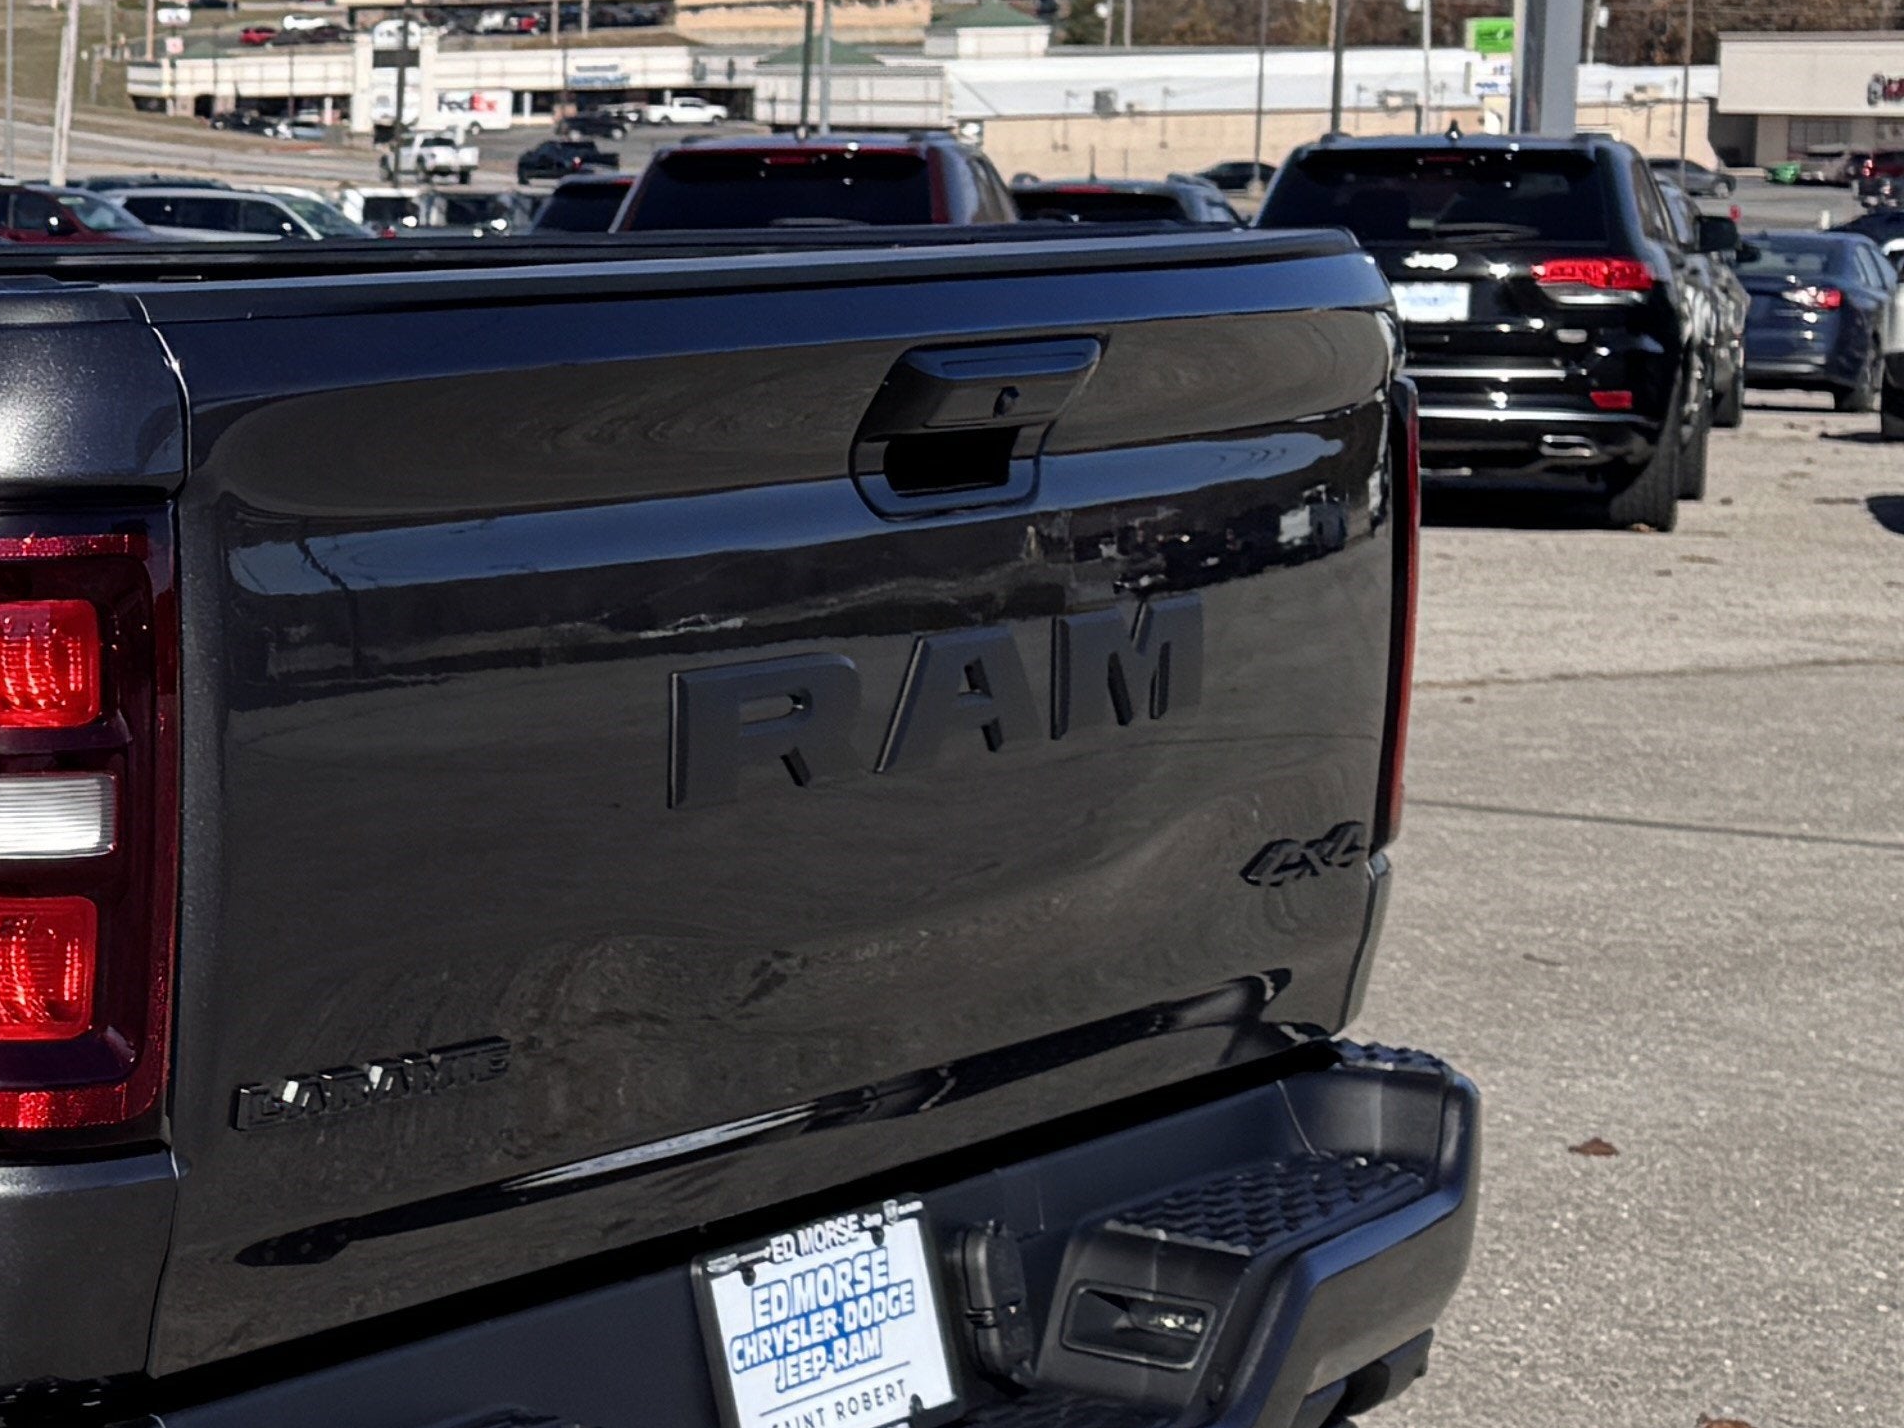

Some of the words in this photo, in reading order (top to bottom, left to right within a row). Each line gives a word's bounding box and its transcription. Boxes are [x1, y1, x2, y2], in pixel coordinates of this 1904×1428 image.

[666, 594, 1204, 810] RAM
[229, 1035, 512, 1132] LARAMIE
[769, 1234, 798, 1264] ED
[798, 1213, 860, 1259] MORSE
[751, 1277, 789, 1327] ED
[790, 1247, 890, 1318] MORSE
[835, 1379, 907, 1422] ROBERT
